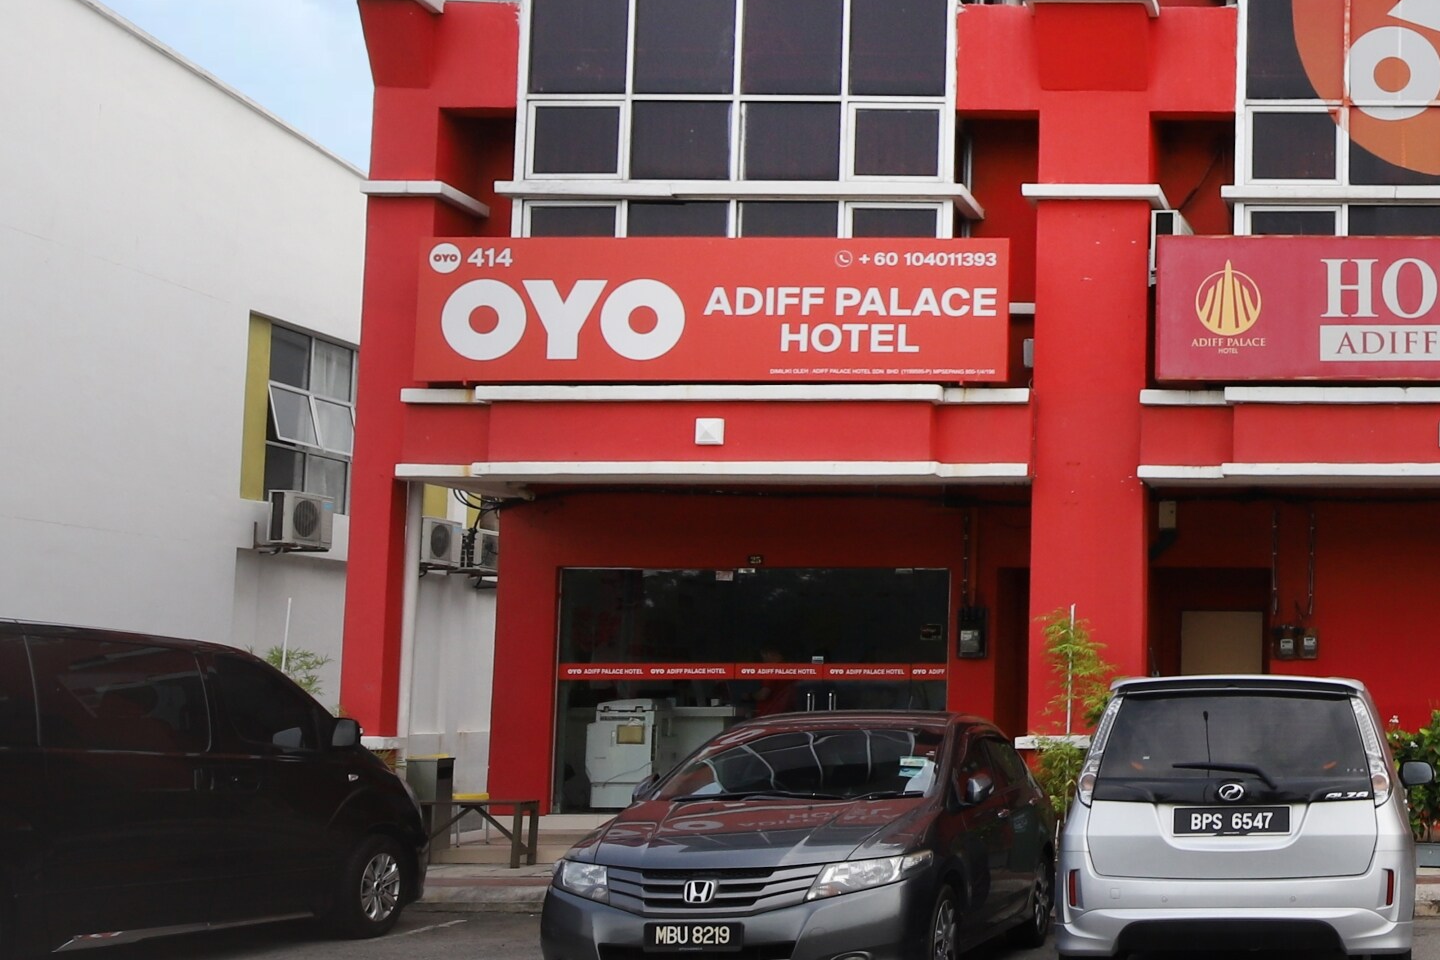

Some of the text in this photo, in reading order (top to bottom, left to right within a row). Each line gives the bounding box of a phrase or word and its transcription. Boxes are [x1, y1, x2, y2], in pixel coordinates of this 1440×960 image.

[433, 248, 513, 267] OYO 414
[874, 252, 898, 267] 60
[904, 252, 997, 267] 104011393
[703, 287, 997, 317] ADIFF PALACE
[441, 278, 686, 361] OYO
[780, 324, 919, 353] HOTEL
[1191, 337, 1267, 347] ADIFF PALACE
[1335, 331, 1438, 355] ADIFF
[650, 667, 726, 675] OYO ADIFF PALACE HOTEL
[1325, 791, 1369, 799] ALZA
[1190, 812, 1273, 830] BPS 6547
[655, 925, 730, 944] MBU 8219
